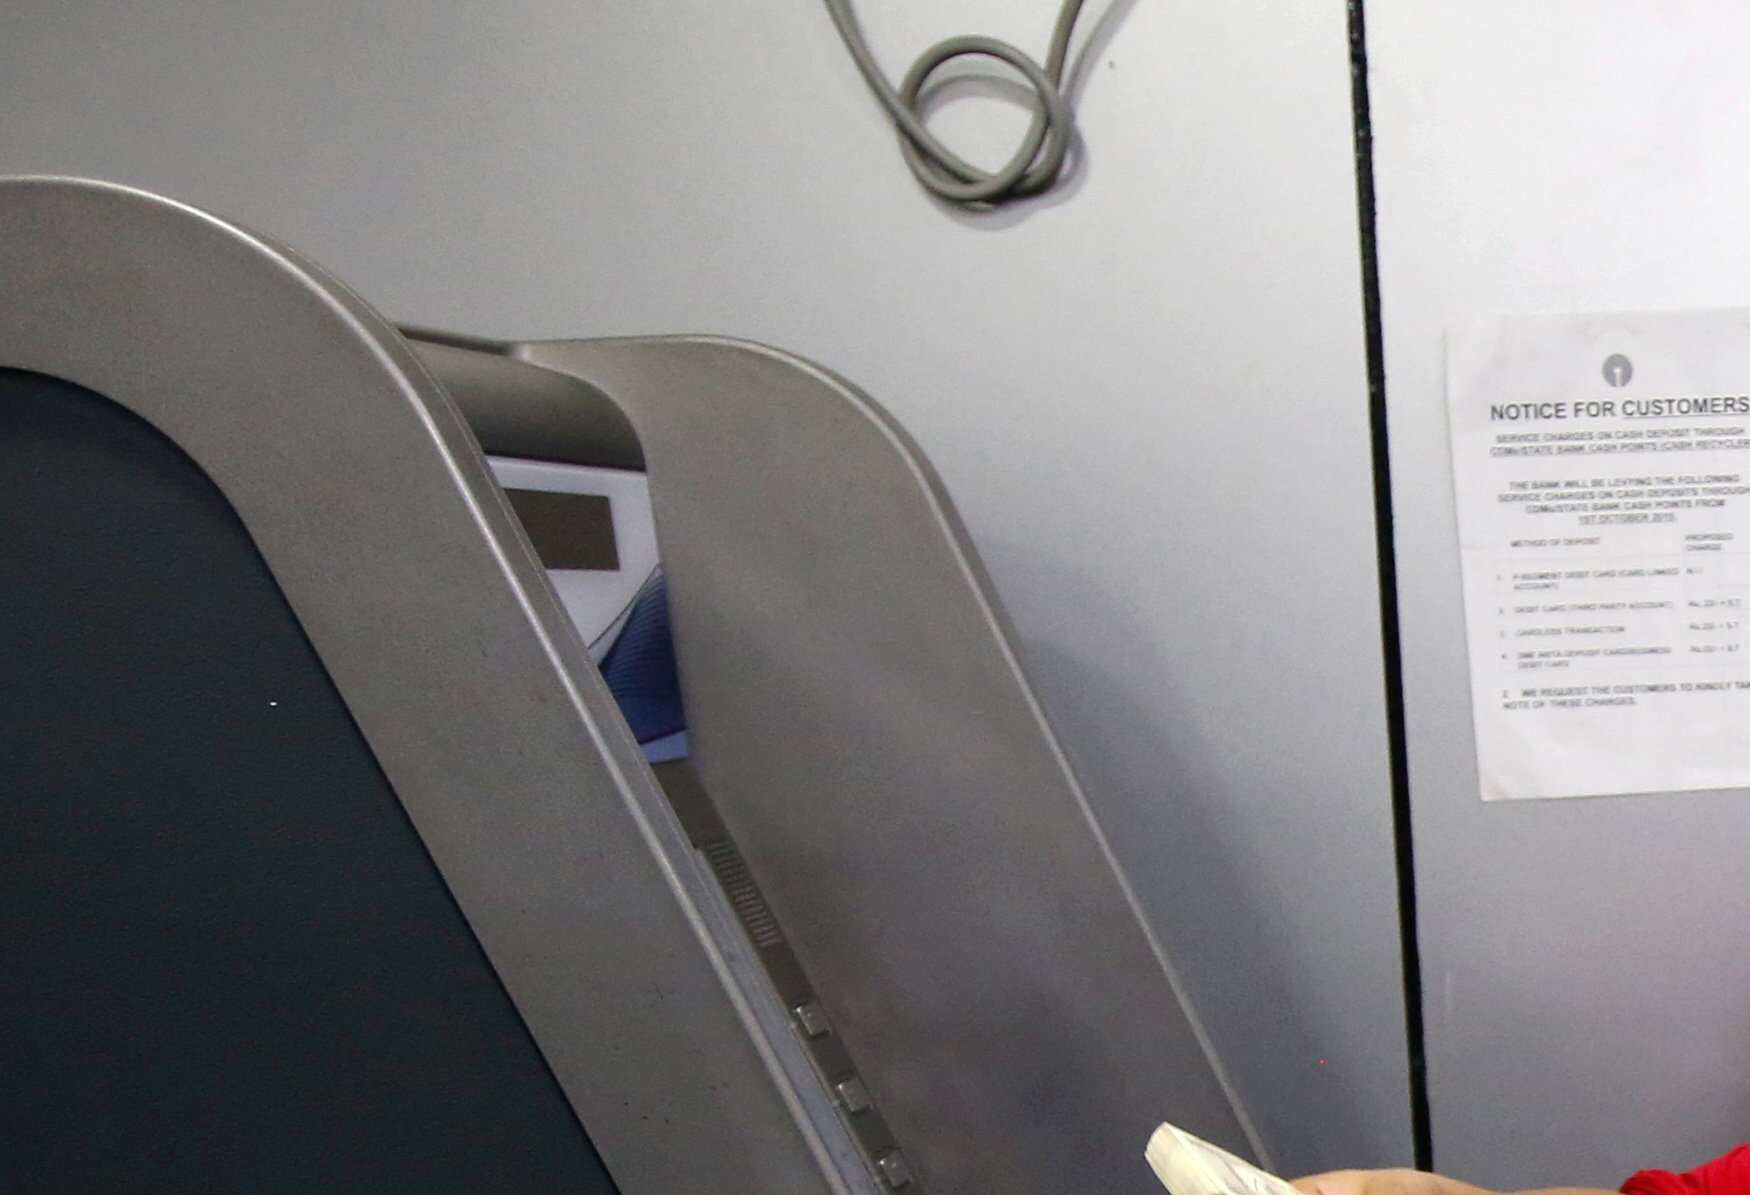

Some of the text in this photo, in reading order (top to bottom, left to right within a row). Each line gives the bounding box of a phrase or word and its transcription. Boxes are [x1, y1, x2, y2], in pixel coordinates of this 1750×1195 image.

[1490, 402, 1567, 421] NOTICE
[1573, 400, 1616, 419] FOR
[1496, 427, 1746, 444] SERVICE CHARGES ON CASH DEPOSIT THROUGH
[1557, 444, 1586, 456] BANK
[1588, 443, 1618, 454] CASH
[1620, 441, 1657, 452] POINTS
[1662, 440, 1694, 451] (CASH
[1509, 480, 1530, 491] THE
[1531, 479, 1560, 491] BANK
[1564, 478, 1589, 489] WILL
[1591, 478, 1605, 488] BE
[1655, 475, 1675, 486] THE
[1677, 474, 1741, 484] FOLLOWING
[1498, 492, 1542, 504] SERVICE
[1544, 491, 1595, 502] CHARGES
[1599, 490, 1614, 500] ON
[1615, 489, 1644, 499] CASH
[1647, 487, 1699, 498] DEPOSITS
[1591, 502, 1620, 512] BANK
[1623, 501, 1652, 511] CASH
[1655, 500, 1693, 510] POINTS
[1695, 499, 1726, 508] FROM
[1599, 514, 1650, 524] OCTOBER
[1540, 687, 1588, 698] REQUEST
[1591, 686, 1612, 696] THE
[1613, 683, 1677, 695] CUSTOMERS
[1680, 682, 1693, 692] TO
[1503, 700, 1531, 711] NOTE
[1549, 699, 1582, 708] THESE
